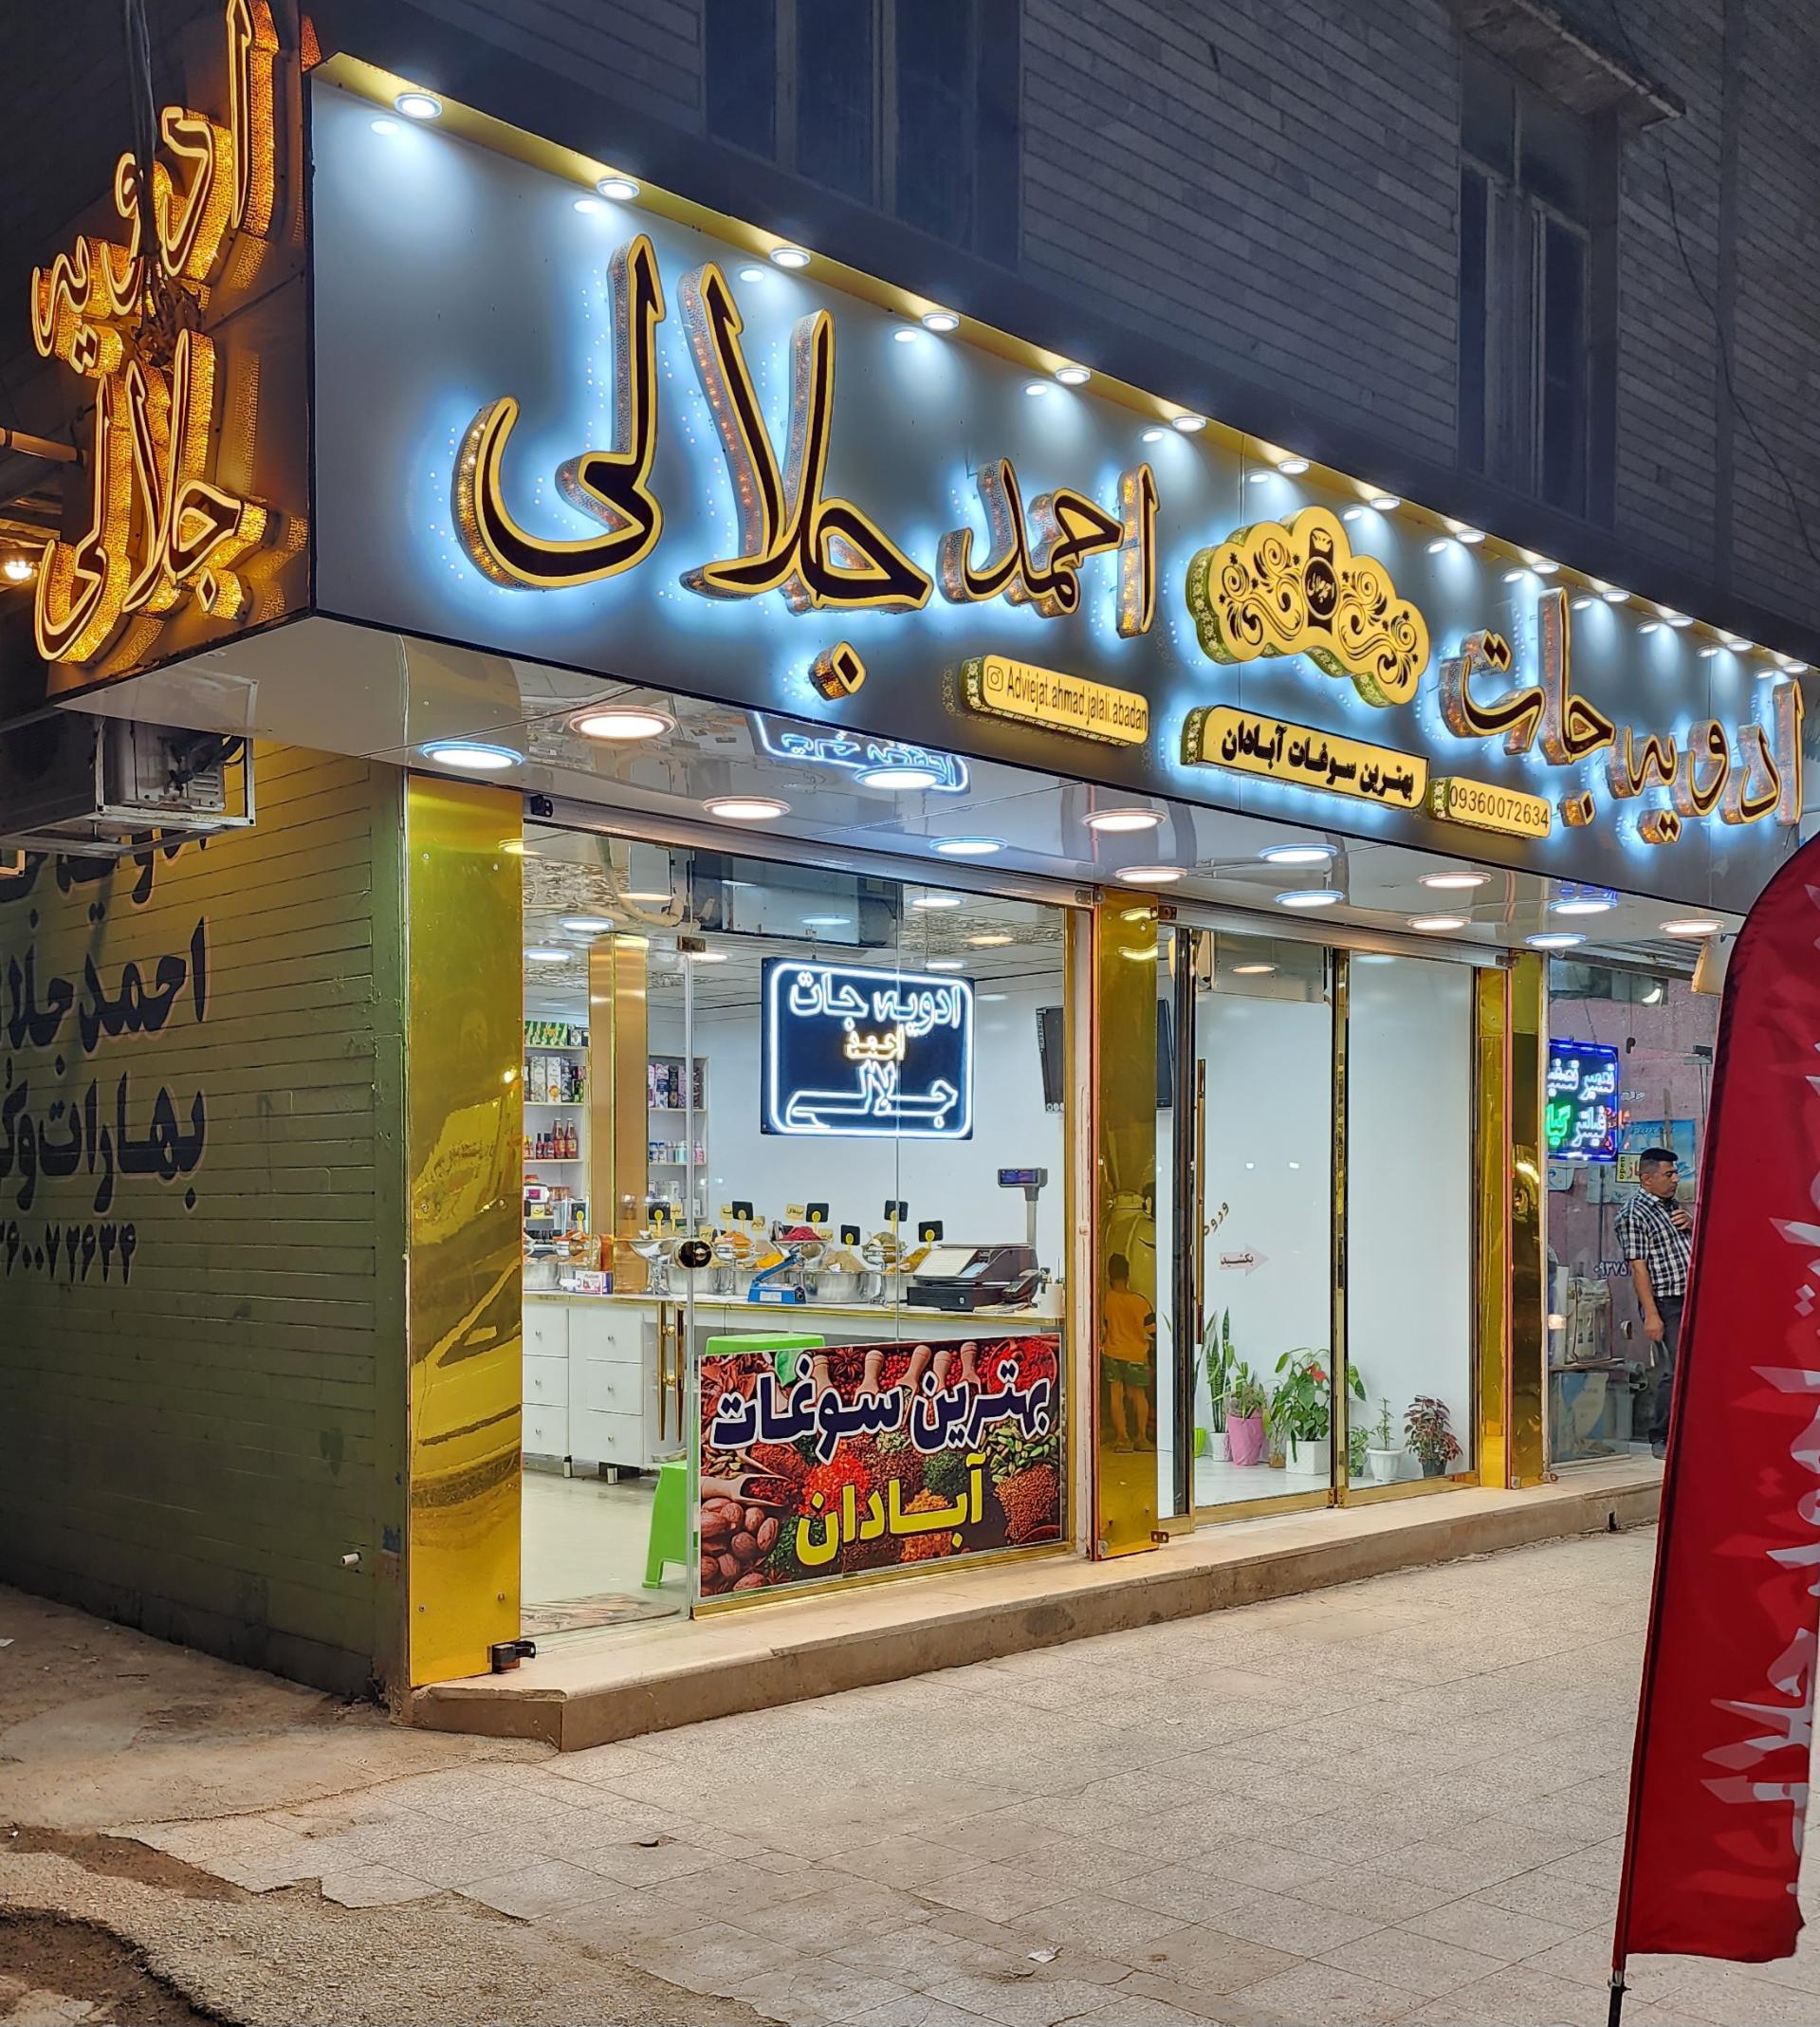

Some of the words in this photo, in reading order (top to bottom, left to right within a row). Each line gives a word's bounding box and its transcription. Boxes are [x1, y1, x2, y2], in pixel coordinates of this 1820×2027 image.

[33, 328, 256, 662] جلالی
[452, 233, 934, 702] جلالی
[938, 456, 1161, 639] احمد
[1005, 665, 1148, 732] Adviejat.ahmad.jalali.abadan
[1440, 586, 1615, 828] جات
[1449, 787, 1549, 826] 09360072634
[79, 914, 207, 1054] احمد
[789, 969, 870, 1033] جات
[872, 985, 963, 1038] ادویه
[38, 1070, 206, 1214] بهارات
[785, 1058, 959, 1130] جلالی
[1221, 1253, 1254, 1267] بکشید
[1594, 1261, 1632, 1277] ۰۹۳۷۵
[709, 1352, 905, 1466] سوغات
[910, 1358, 1052, 1454] بهترین
[795, 1451, 987, 1567] آبادان
